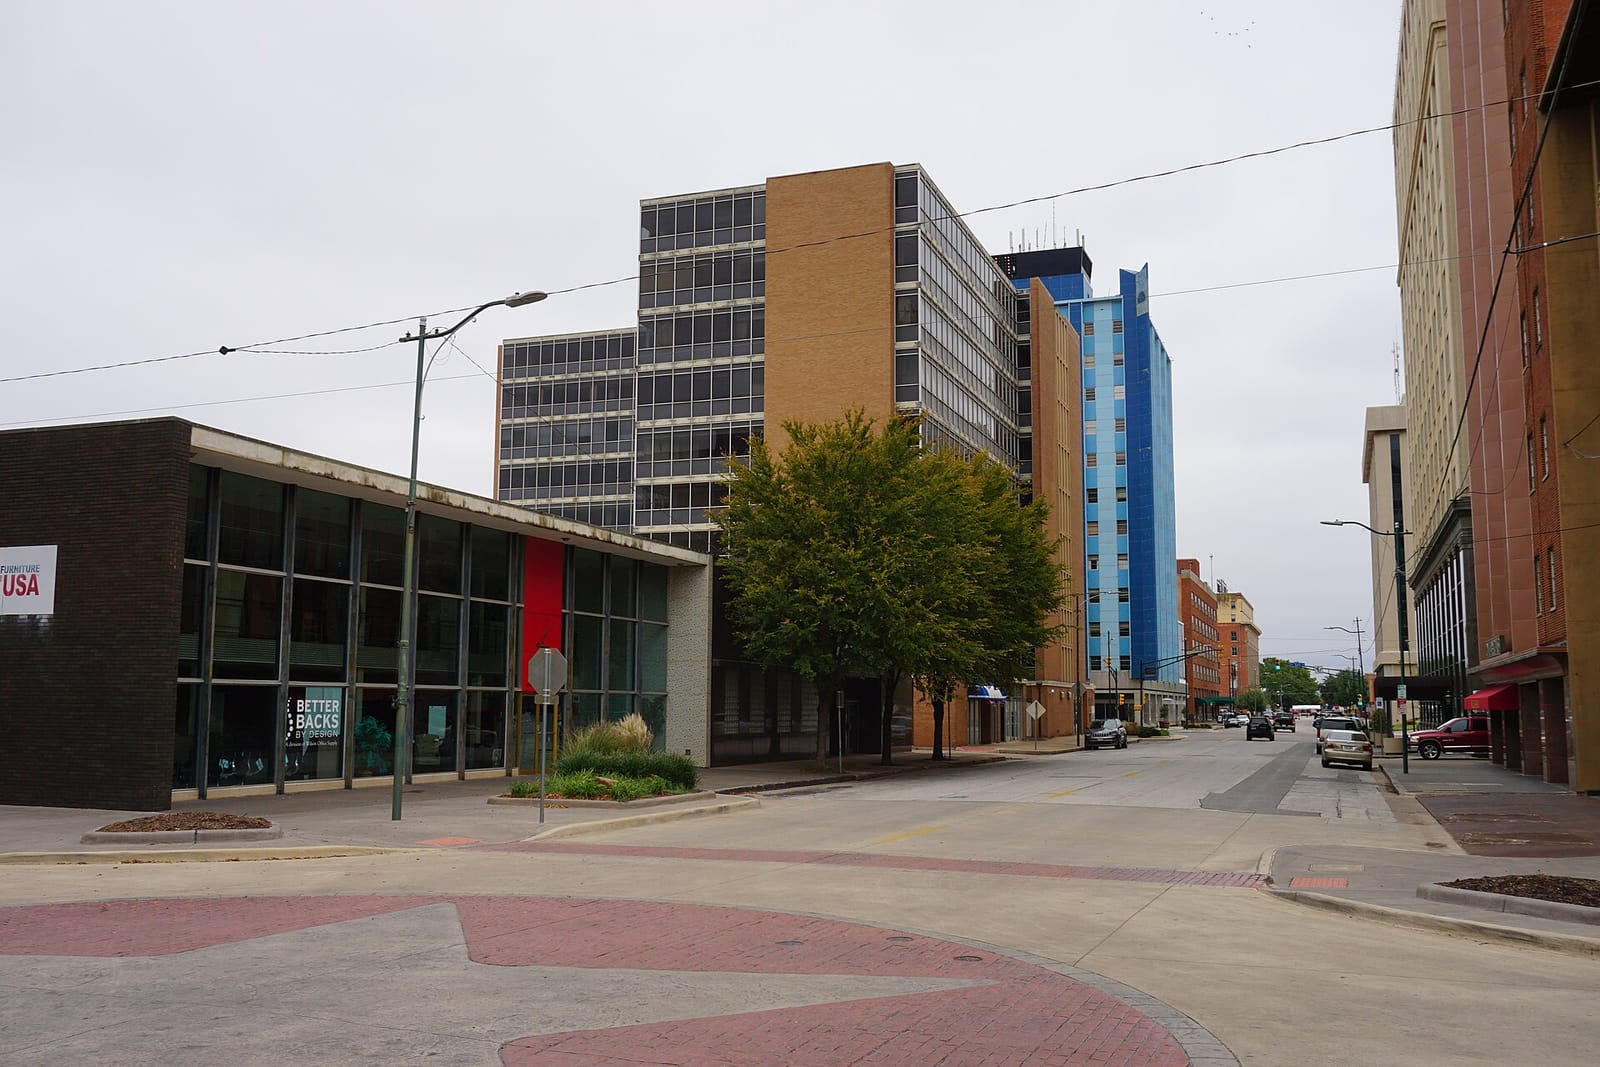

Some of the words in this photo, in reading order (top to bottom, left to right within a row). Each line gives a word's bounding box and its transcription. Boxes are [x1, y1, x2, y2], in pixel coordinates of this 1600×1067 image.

[0, 564, 40, 574] FURNITURE
[0, 573, 40, 597] USA
[296, 699, 339, 713] BETTER
[296, 713, 339, 729] BACKS
[295, 730, 306, 739] BY
[309, 730, 338, 738] DESIGN
